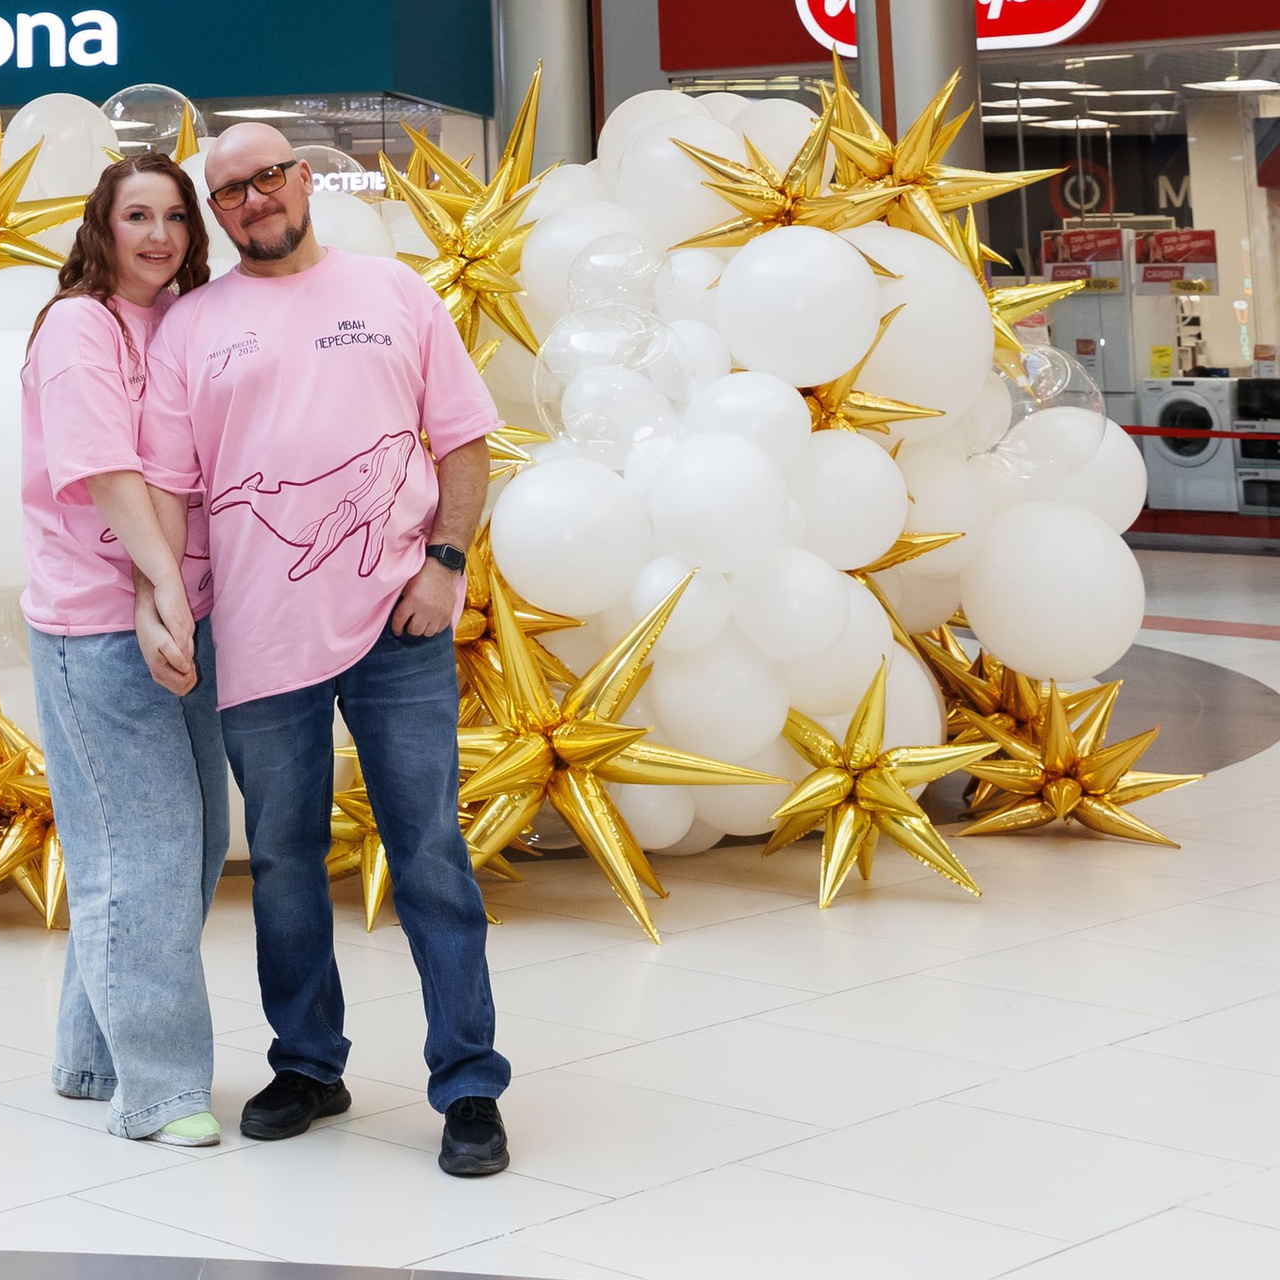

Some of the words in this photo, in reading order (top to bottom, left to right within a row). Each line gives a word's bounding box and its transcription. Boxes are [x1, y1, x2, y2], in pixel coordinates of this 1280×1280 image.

[337, 320, 366, 331] ИВАН
[314, 332, 393, 351] ПЕРЕСКОКОВ
[237, 344, 260, 357] 2025
